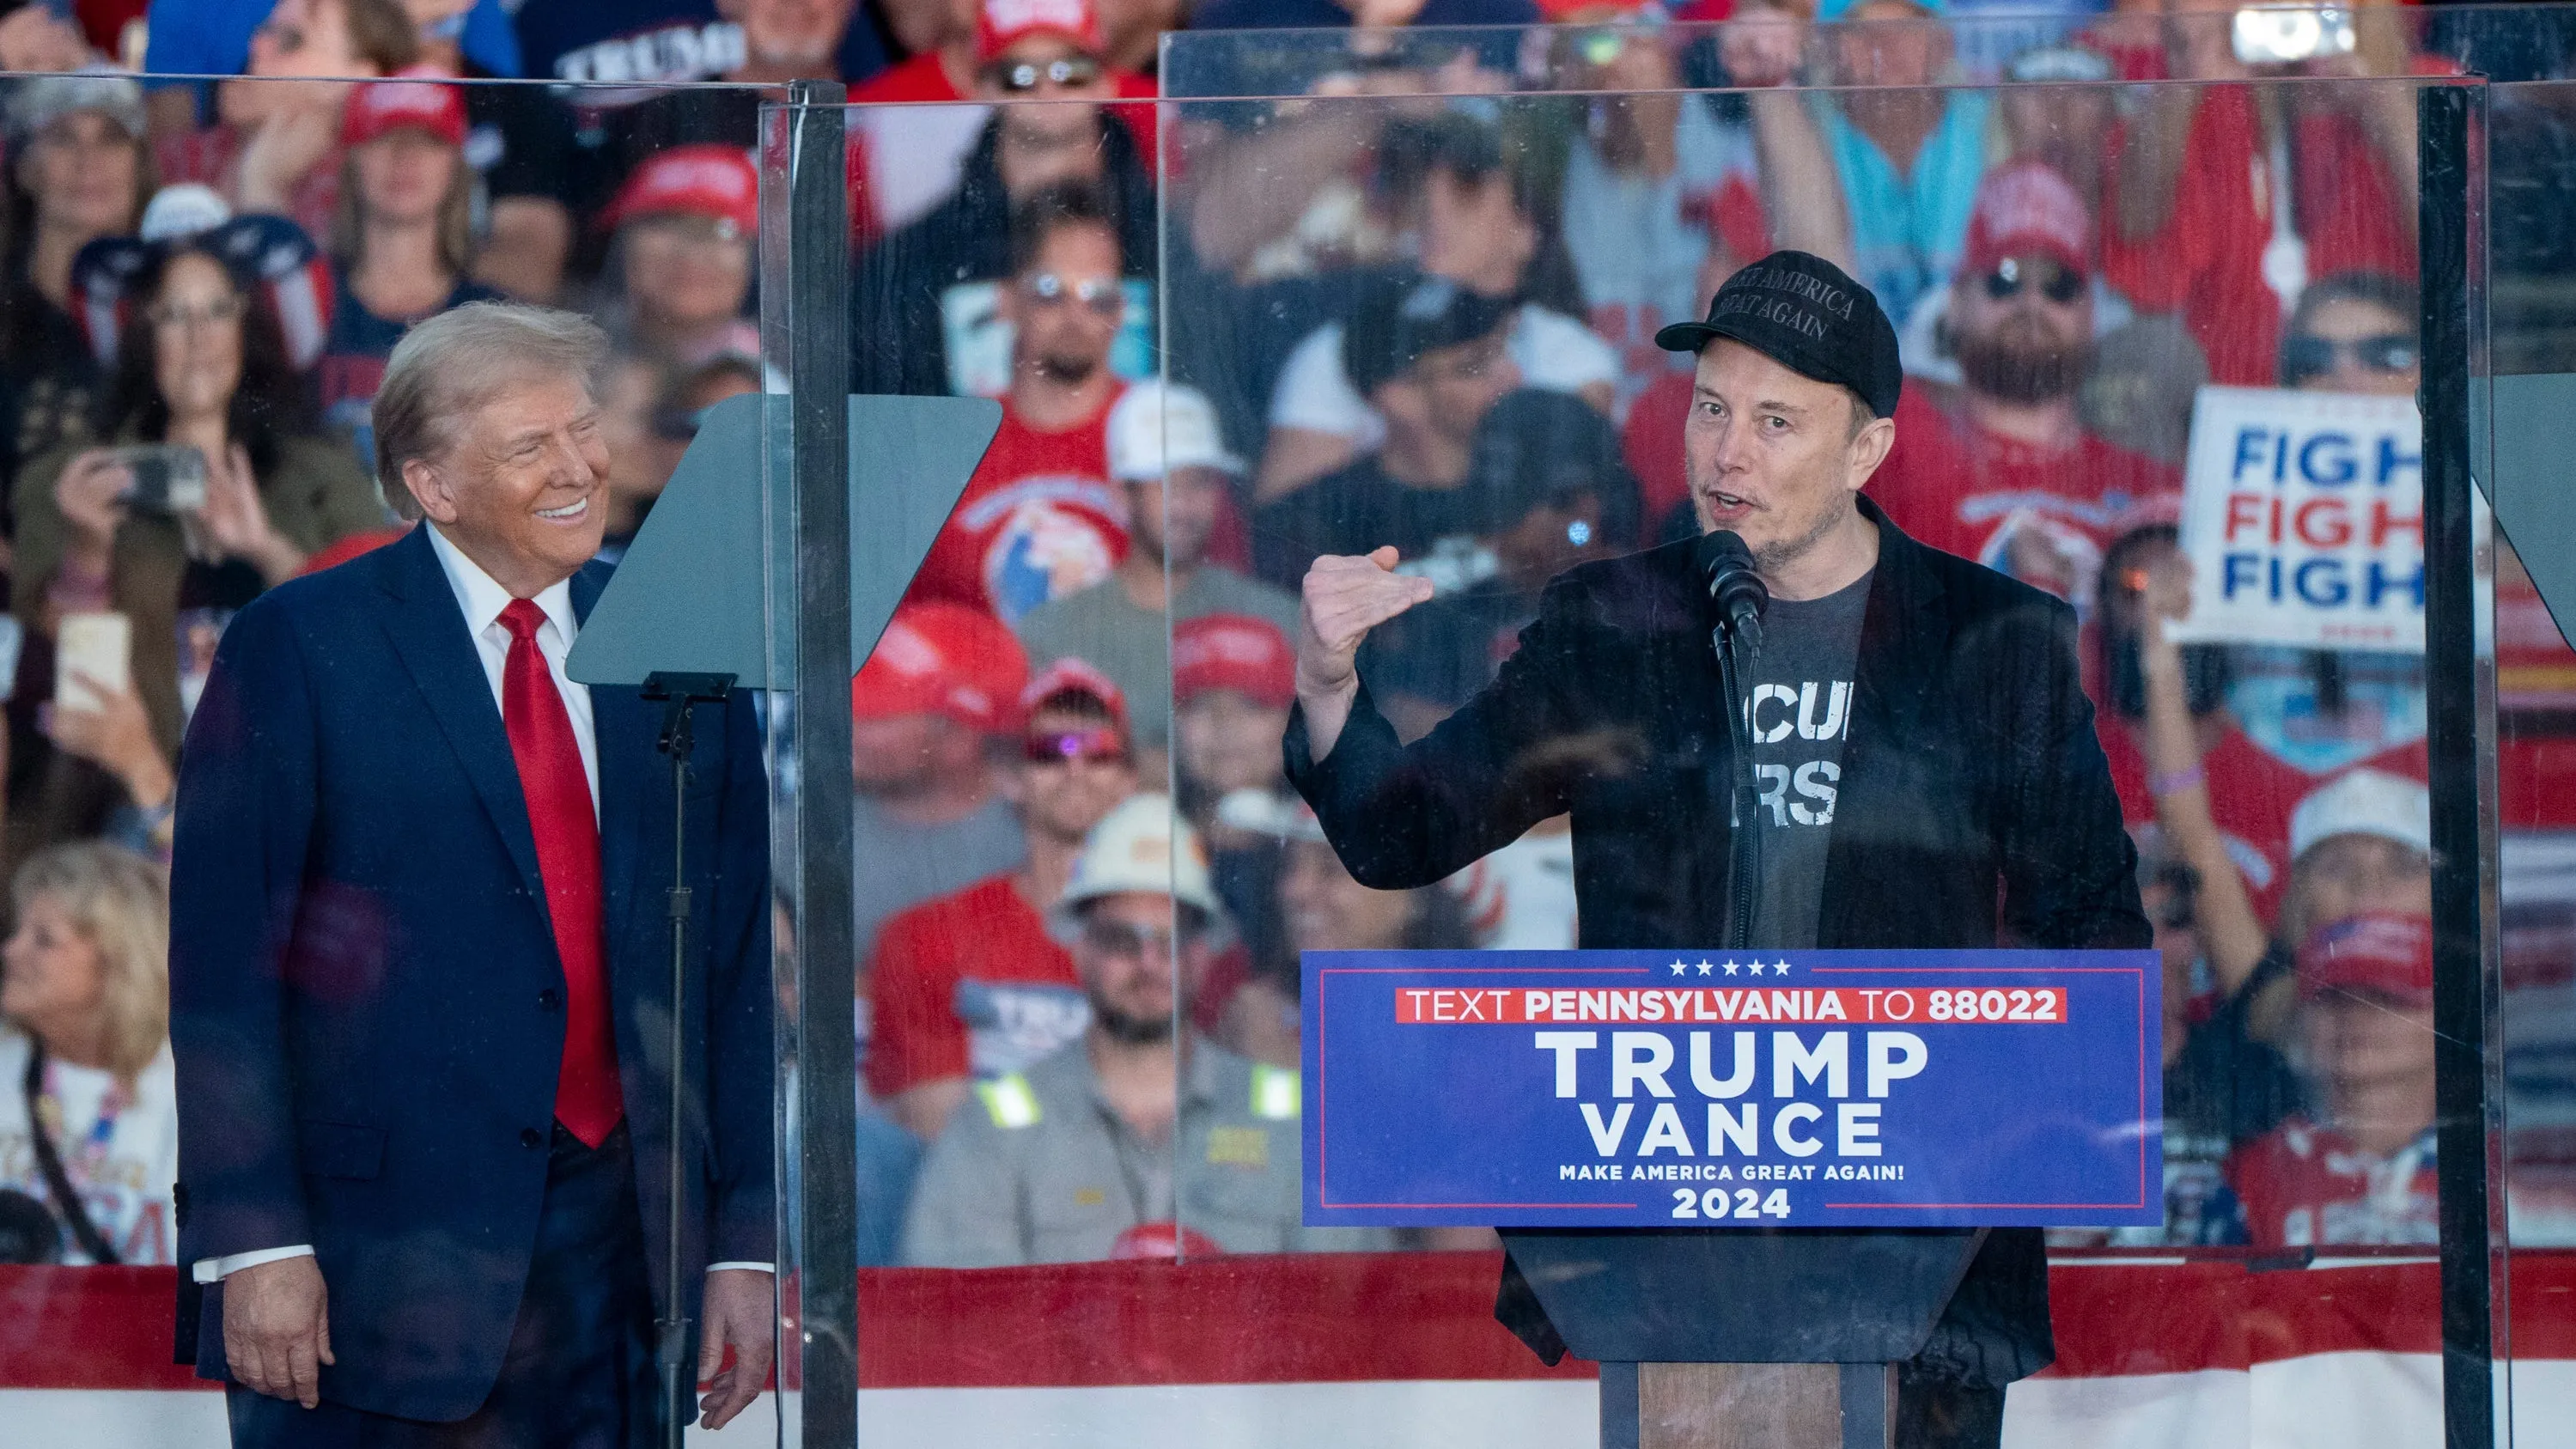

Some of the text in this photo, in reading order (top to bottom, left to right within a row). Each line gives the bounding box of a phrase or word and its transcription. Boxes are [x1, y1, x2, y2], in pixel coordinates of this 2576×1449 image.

[1756, 297, 1829, 341] AGAIN
[1759, 269, 1855, 320] AMERICA
[2232, 427, 2421, 487] FIGH
[2224, 492, 2423, 550] FIGH
[2221, 552, 2425, 609] FIGH
[1406, 990, 2057, 1020] TEXT PENNSYLVANIA TO 88022
[1536, 1032, 1928, 1099] TRUMP
[1580, 1102, 1882, 1157] VANCE
[1560, 1165, 1903, 1180] MAKE AMERICA GREAT AGAIN!
[1672, 1188, 1790, 1218] 2024
